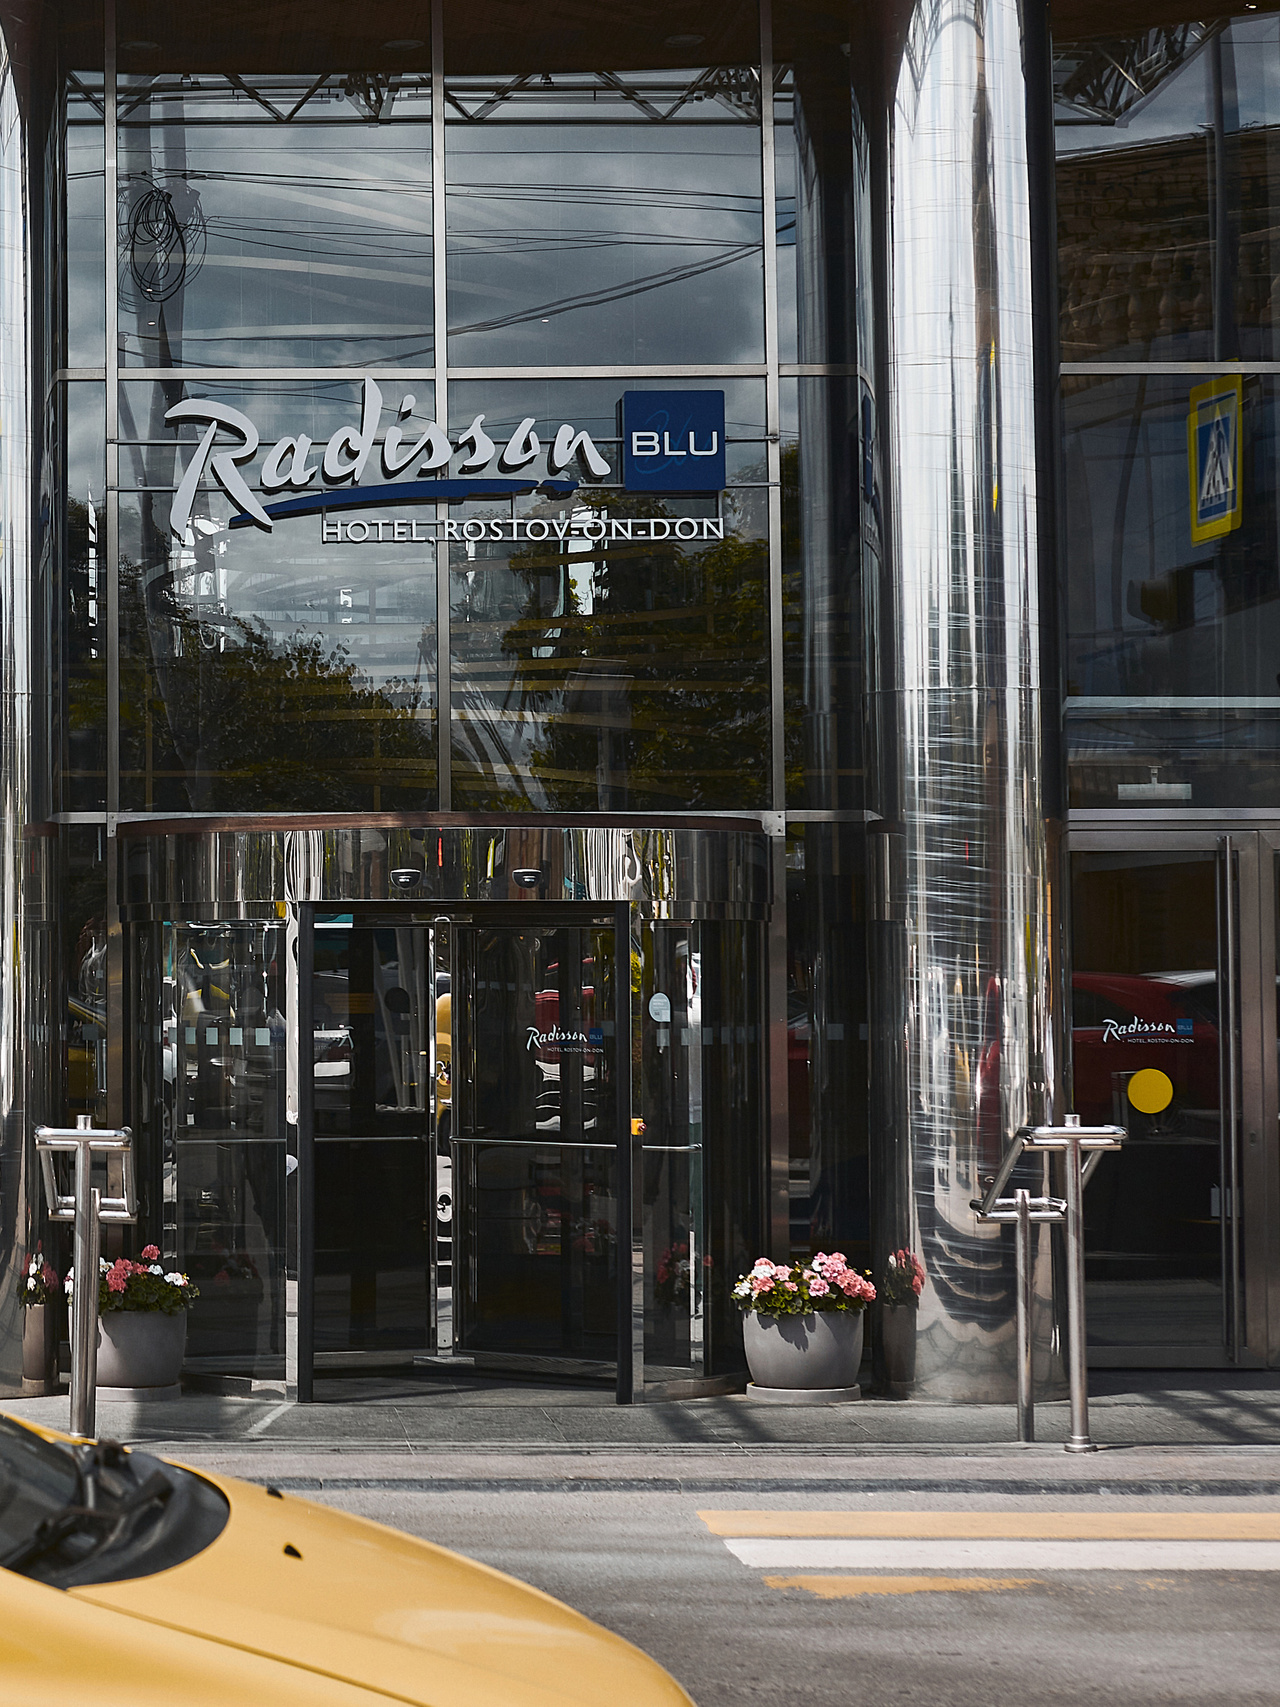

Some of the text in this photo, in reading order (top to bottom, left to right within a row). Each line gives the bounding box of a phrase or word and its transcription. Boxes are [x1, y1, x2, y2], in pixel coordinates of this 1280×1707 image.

[164, 376, 718, 540] Radisson BLU
[322, 517, 725, 544] HOTEL, ROSTOV-ON-DON
[526, 1024, 588, 1051] Radisson
[1102, 1015, 1176, 1043] Radisson
